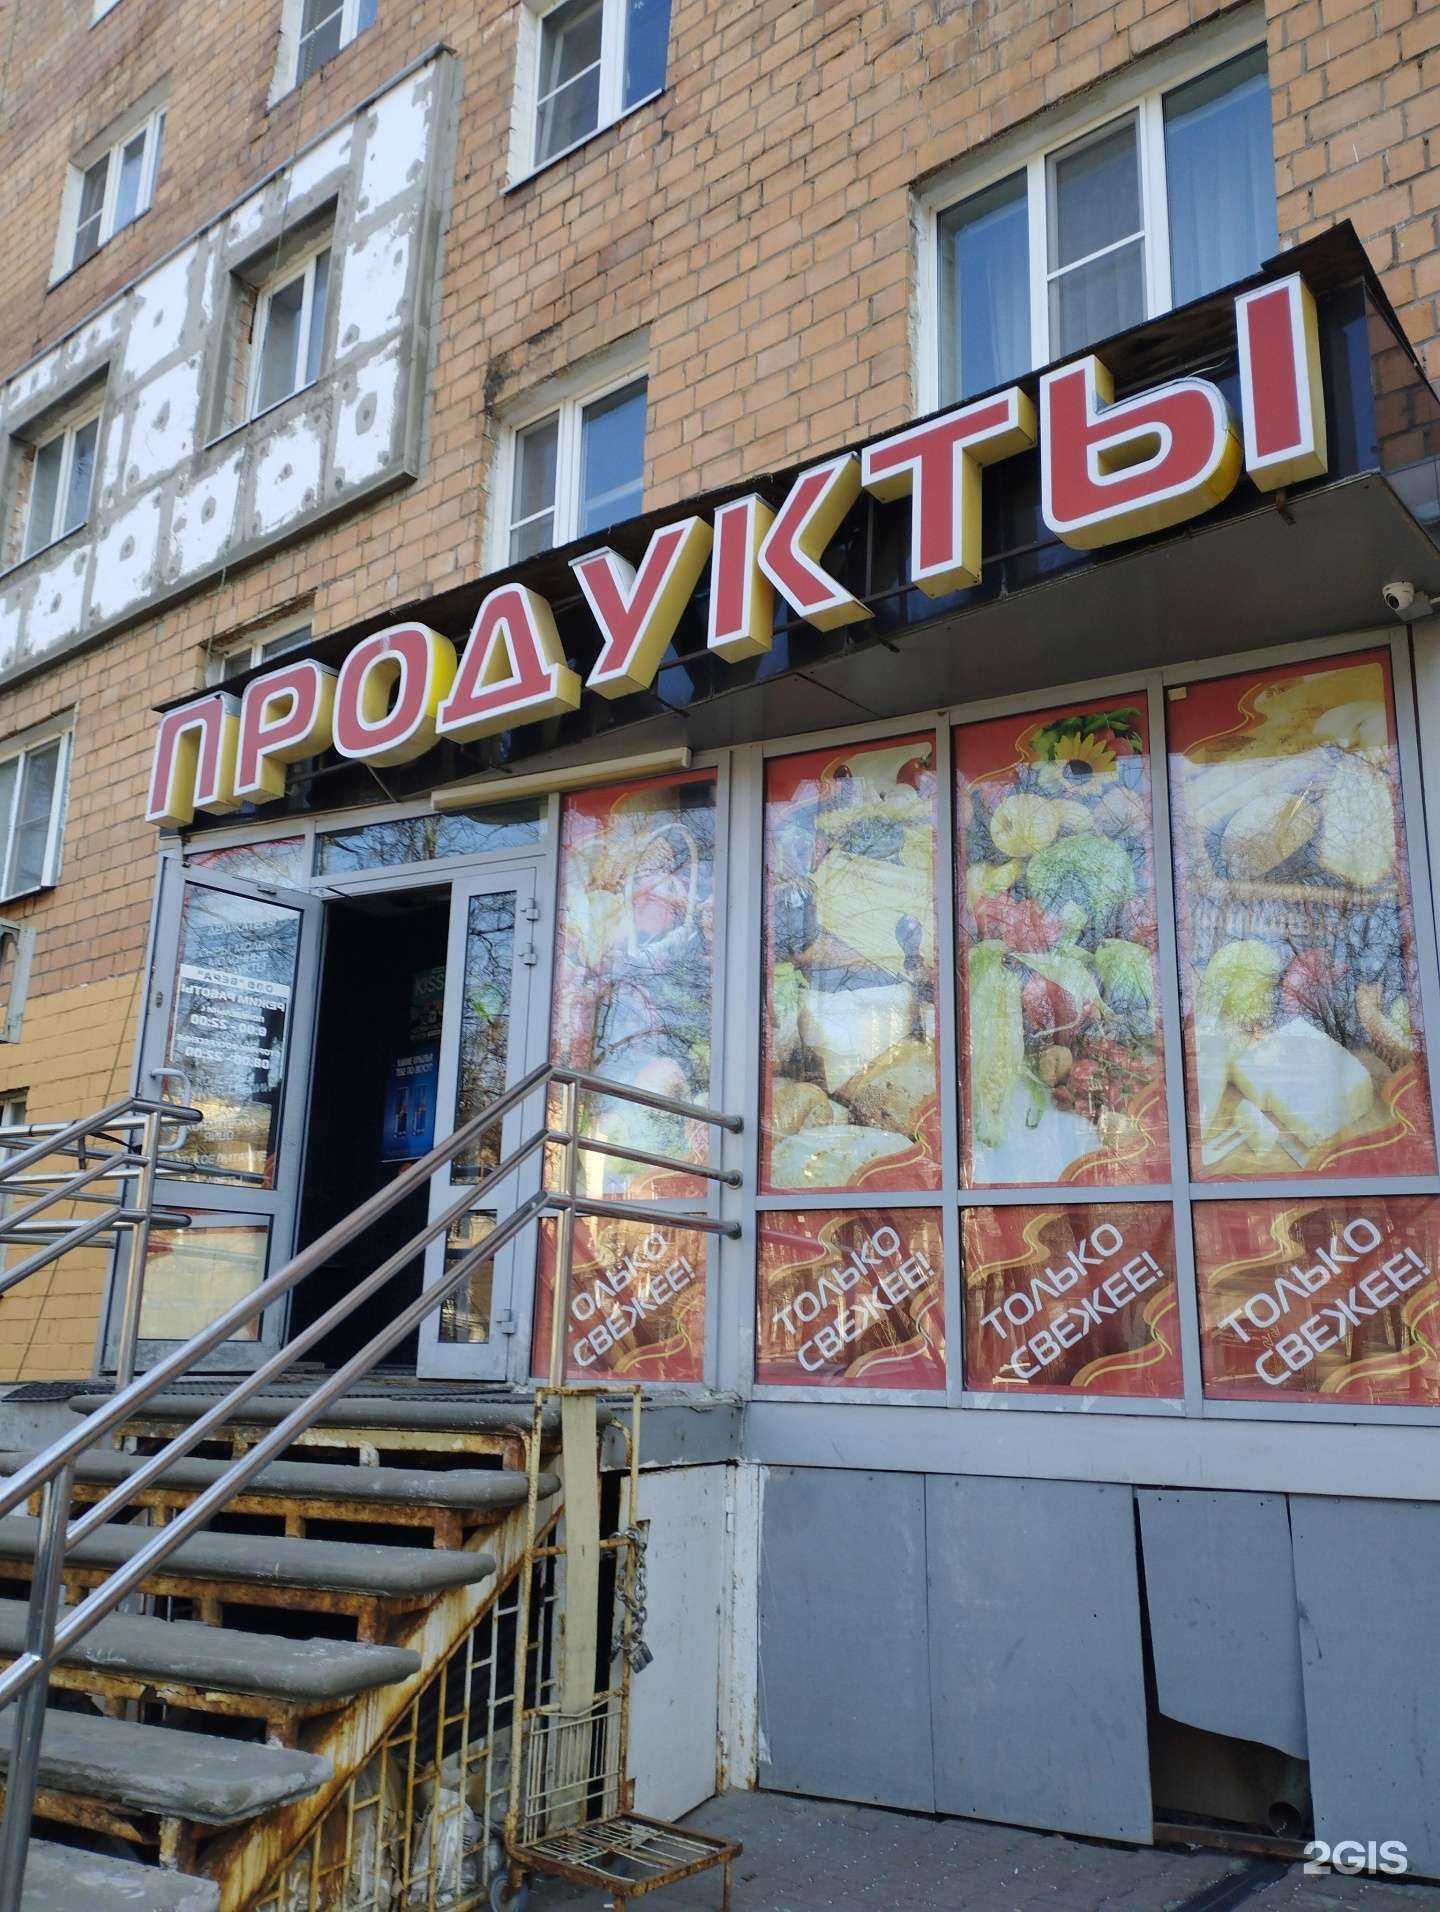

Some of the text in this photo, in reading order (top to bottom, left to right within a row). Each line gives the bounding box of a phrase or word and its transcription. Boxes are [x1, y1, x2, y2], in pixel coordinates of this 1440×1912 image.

[144, 272, 1328, 826] ПРОДУКТЫ
[569, 1232, 668, 1333] ОЛЬКО
[573, 1255, 696, 1367] СВЕЖЕЕ!
[772, 1226, 900, 1335] ТОЛЬКО
[798, 1251, 936, 1372] СВЕЖЕЕ!
[980, 1223, 1124, 1340] ТОЛЬКО
[1010, 1250, 1165, 1379] СВЕЖЕЕ!
[1217, 1218, 1382, 1343] ТОЛЬКО
[1255, 1247, 1431, 1385] СВЕЖЕЕ!
